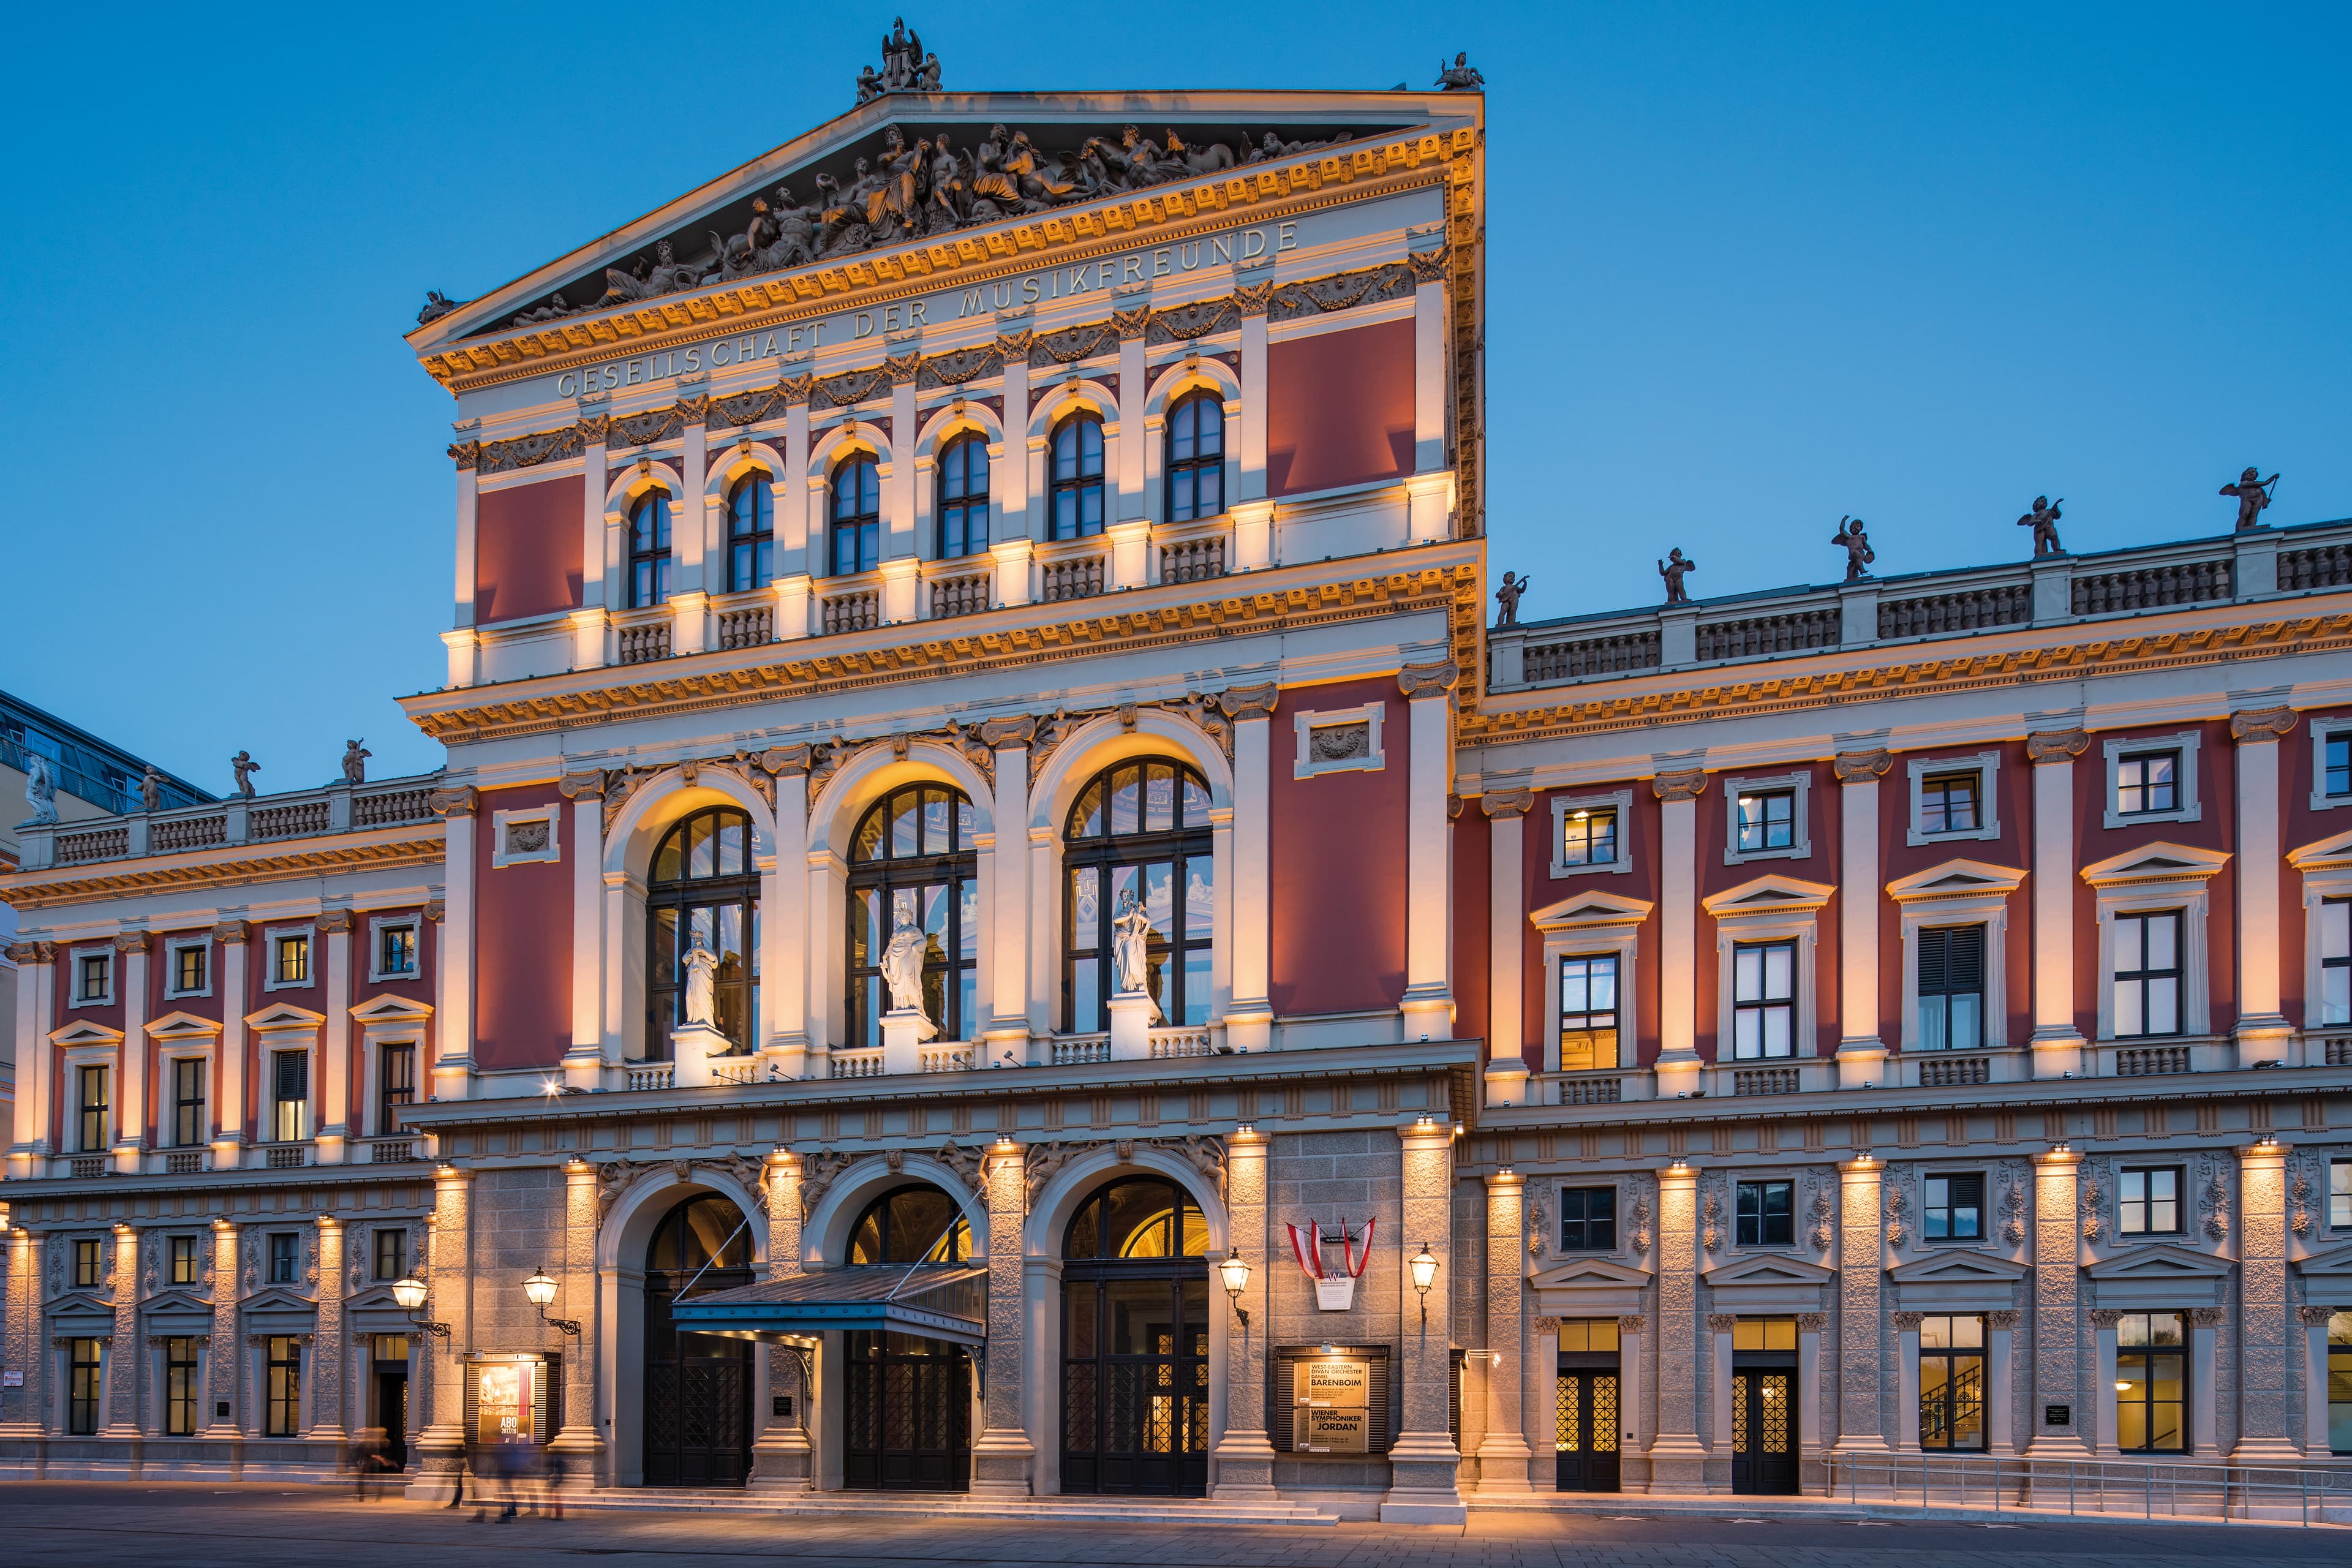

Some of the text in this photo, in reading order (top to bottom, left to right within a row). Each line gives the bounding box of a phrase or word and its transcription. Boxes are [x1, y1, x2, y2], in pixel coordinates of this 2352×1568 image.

[558, 221, 1298, 398] GESELLSCHAFT DER MUSIKFREUNDE
[500, 1416, 517, 1428] ABO
